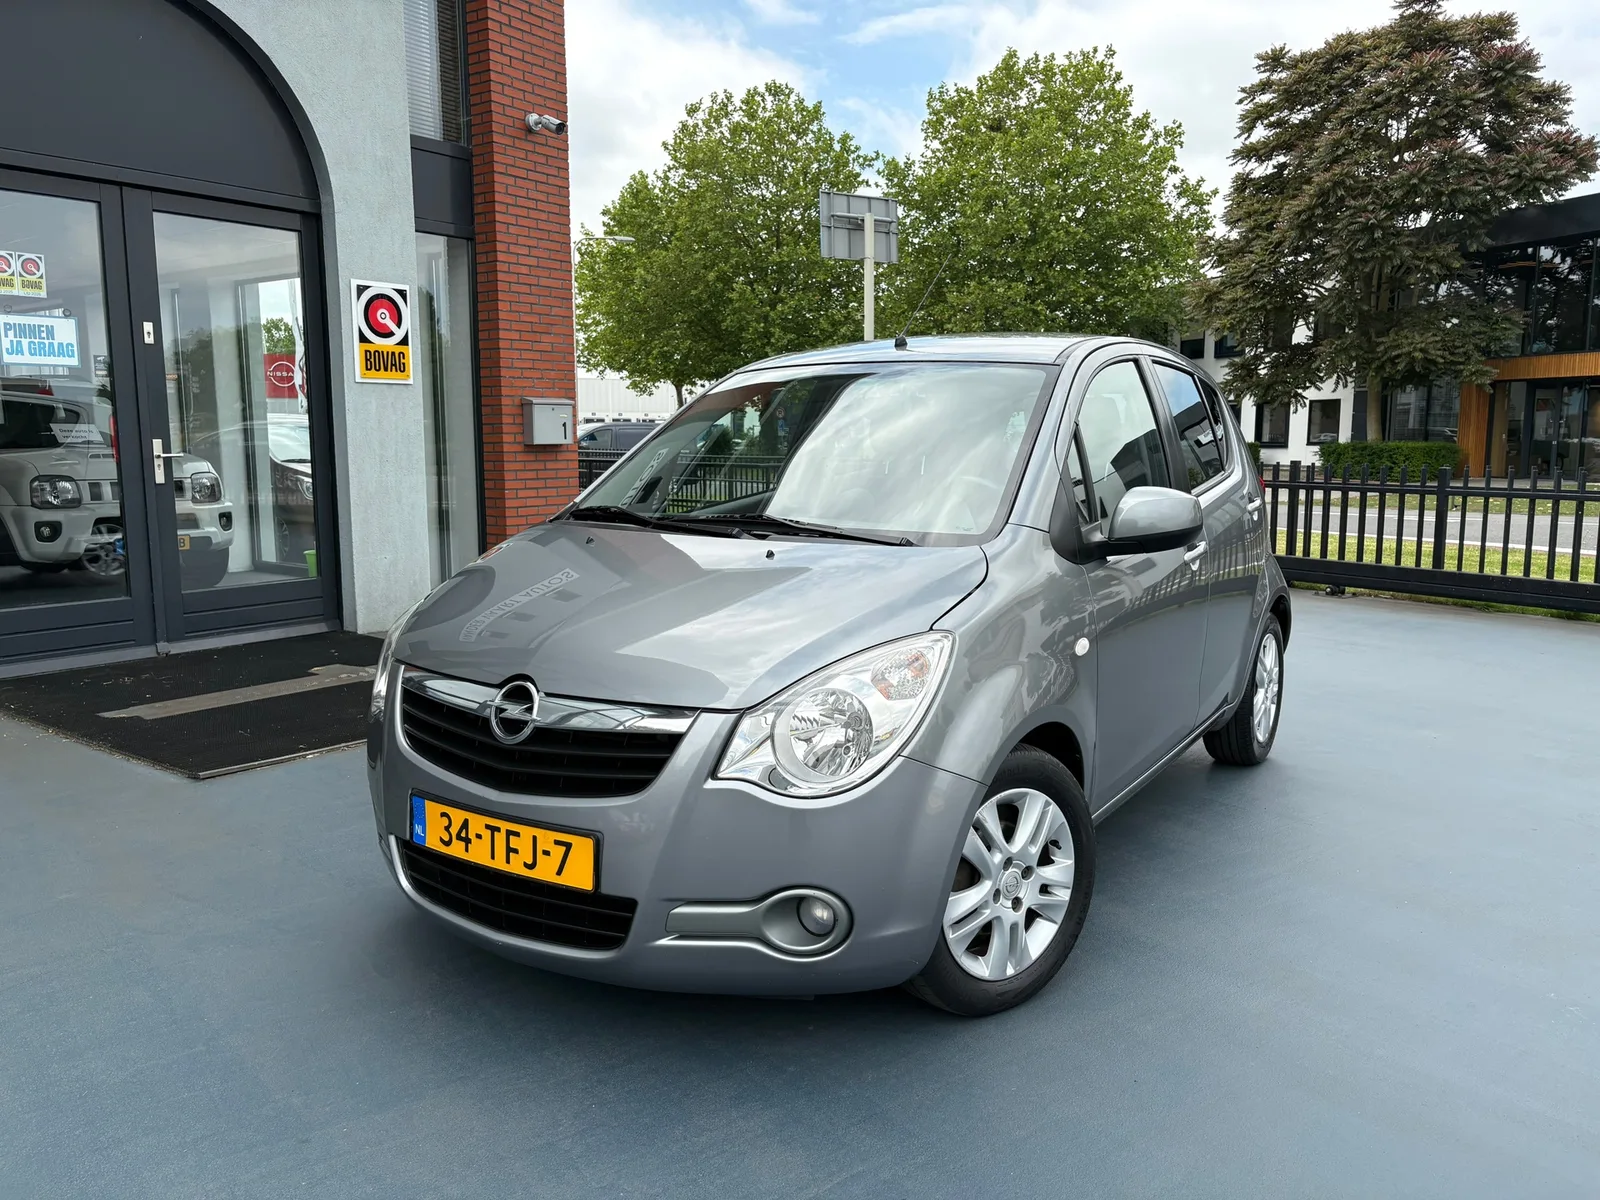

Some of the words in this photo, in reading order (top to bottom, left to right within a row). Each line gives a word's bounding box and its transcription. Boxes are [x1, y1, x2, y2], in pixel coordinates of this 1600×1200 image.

[21, 279, 43, 290] BOVAG
[3, 322, 55, 341] PINNEN
[5, 340, 24, 356] JA
[28, 341, 75, 359] GRAAG
[364, 350, 406, 373] BOVAG
[562, 421, 567, 440] 1
[415, 823, 425, 837] NL
[439, 811, 573, 876] 34-TFJ-7
